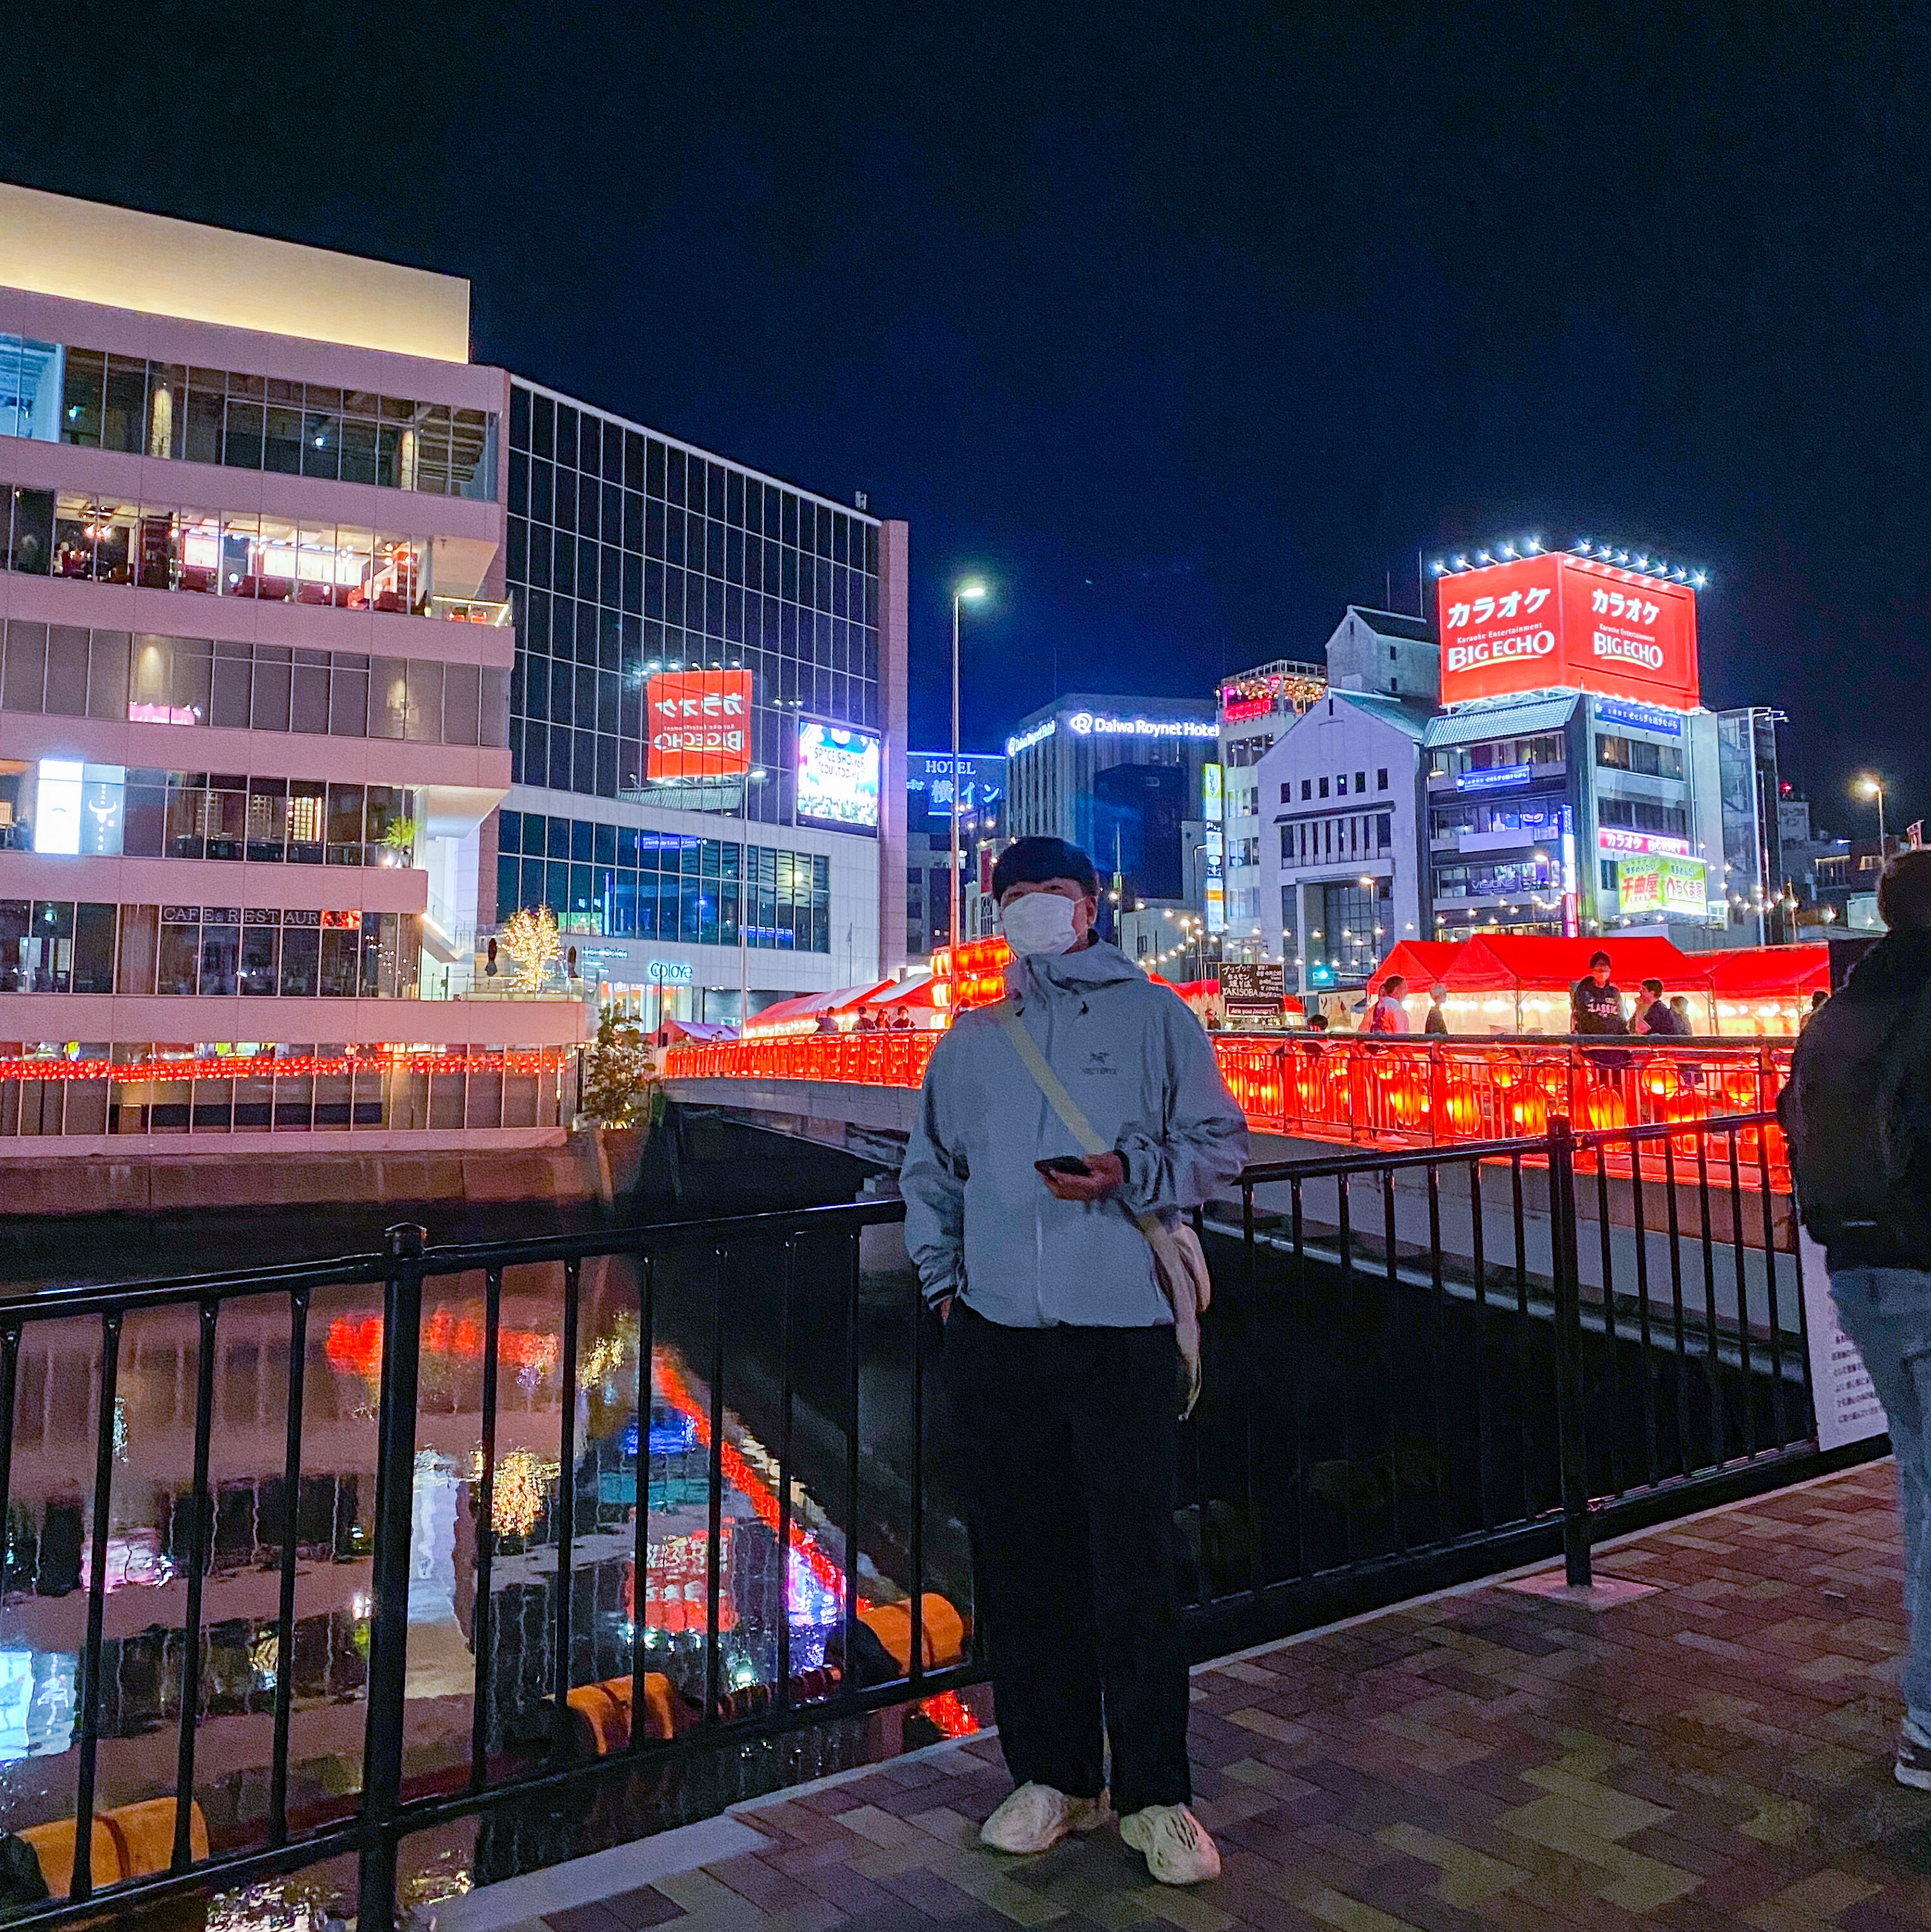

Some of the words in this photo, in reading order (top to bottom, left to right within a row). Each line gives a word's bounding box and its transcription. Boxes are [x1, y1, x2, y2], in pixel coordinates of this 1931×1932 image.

[1447, 588, 1551, 629] カラオケ
[1592, 589, 1660, 625] カラオケ
[1457, 632, 1486, 644] Karaoke
[1488, 622, 1543, 638] Entertainment
[1599, 623, 1620, 634] Karaoke
[1448, 642, 1489, 672] BIG
[1492, 630, 1555, 655] ECHO
[1594, 631, 1622, 656] BIG
[1623, 639, 1663, 669] ECHO
[1095, 718, 1134, 733] Daiwa
[1136, 720, 1182, 737] Roynet
[1184, 722, 1219, 737] Hotel
[925, 760, 977, 775] HOTEL
[906, 779, 1000, 803] 横イン
[1607, 833, 1643, 849] カラオケ
[164, 908, 214, 922] CAFE
[1221, 987, 1258, 996] YAKISOBA
